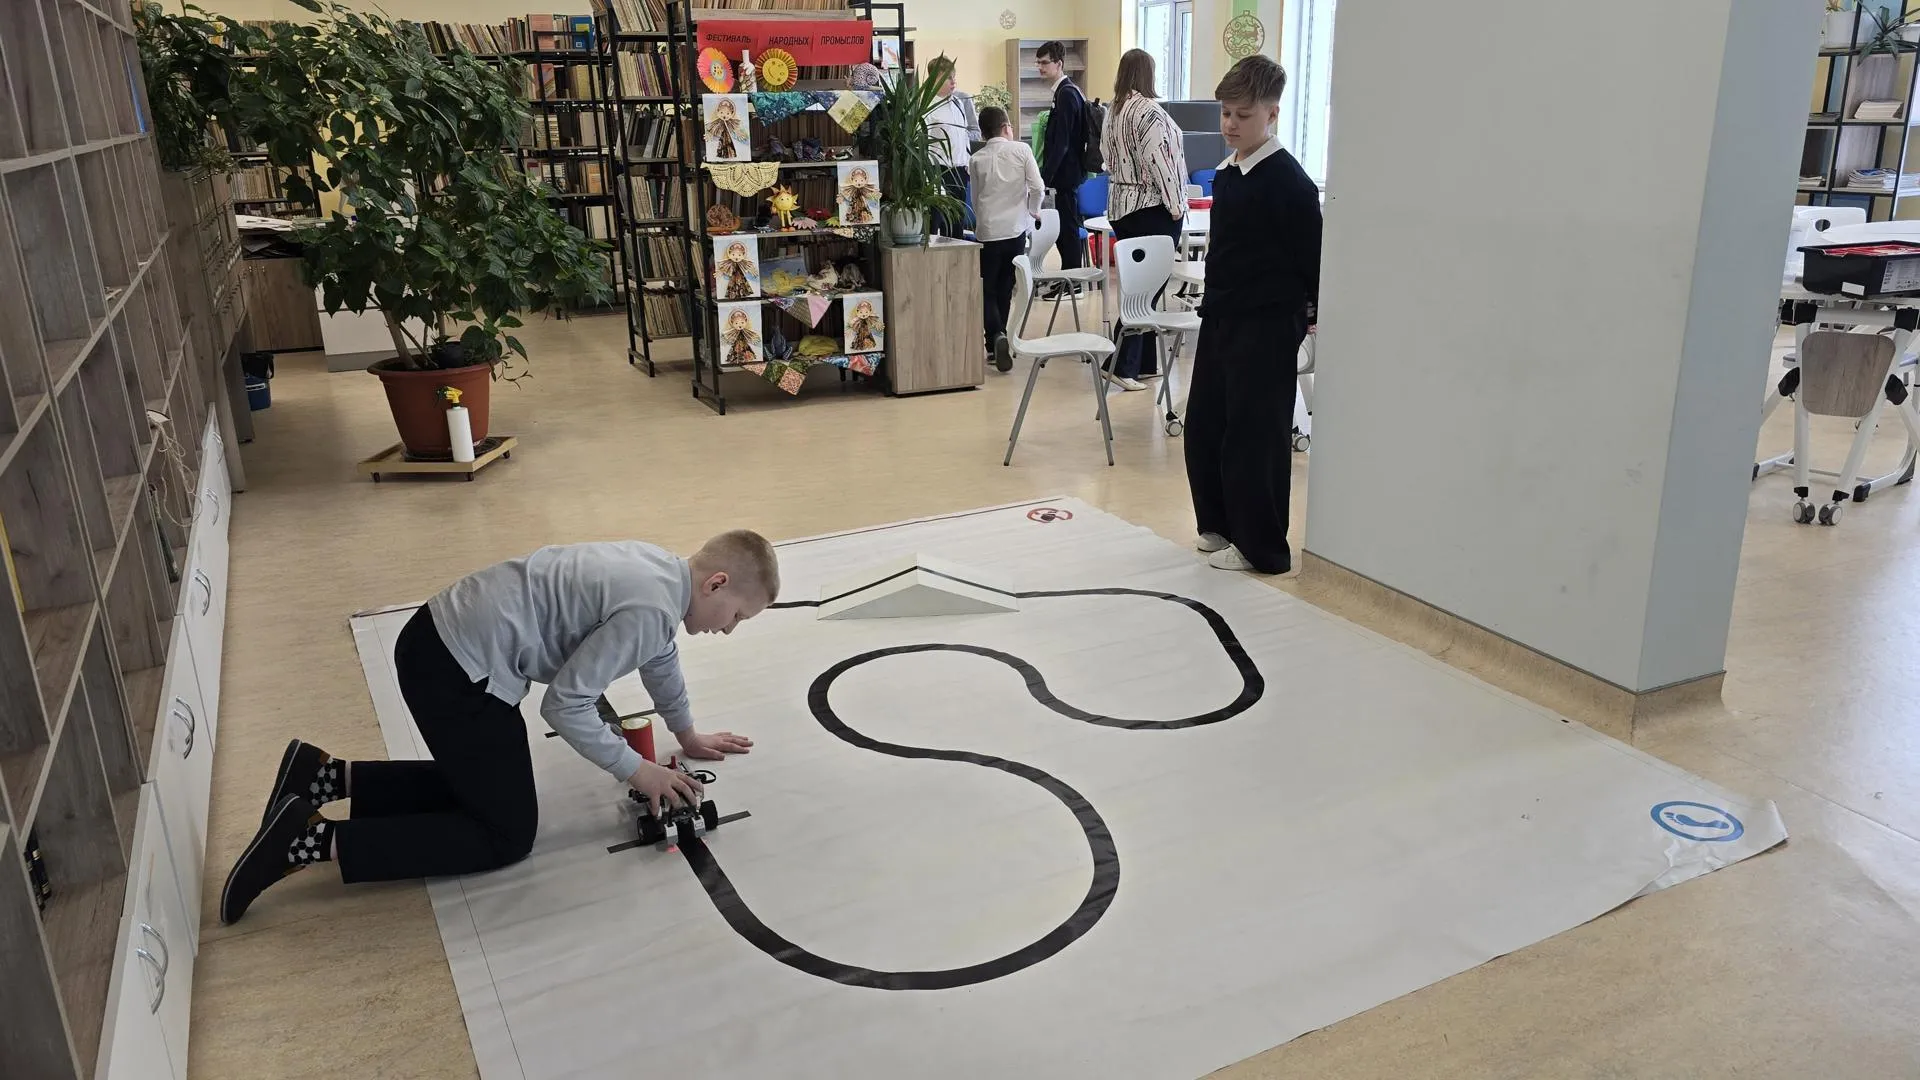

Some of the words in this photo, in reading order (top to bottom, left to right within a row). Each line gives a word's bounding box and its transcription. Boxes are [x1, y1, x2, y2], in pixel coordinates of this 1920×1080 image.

[705, 33, 752, 44] ФЕСТИВАЛЬ
[768, 36, 809, 46] НАРОДНЫХ
[820, 35, 865, 45] ПРОМЫСЛОВ
